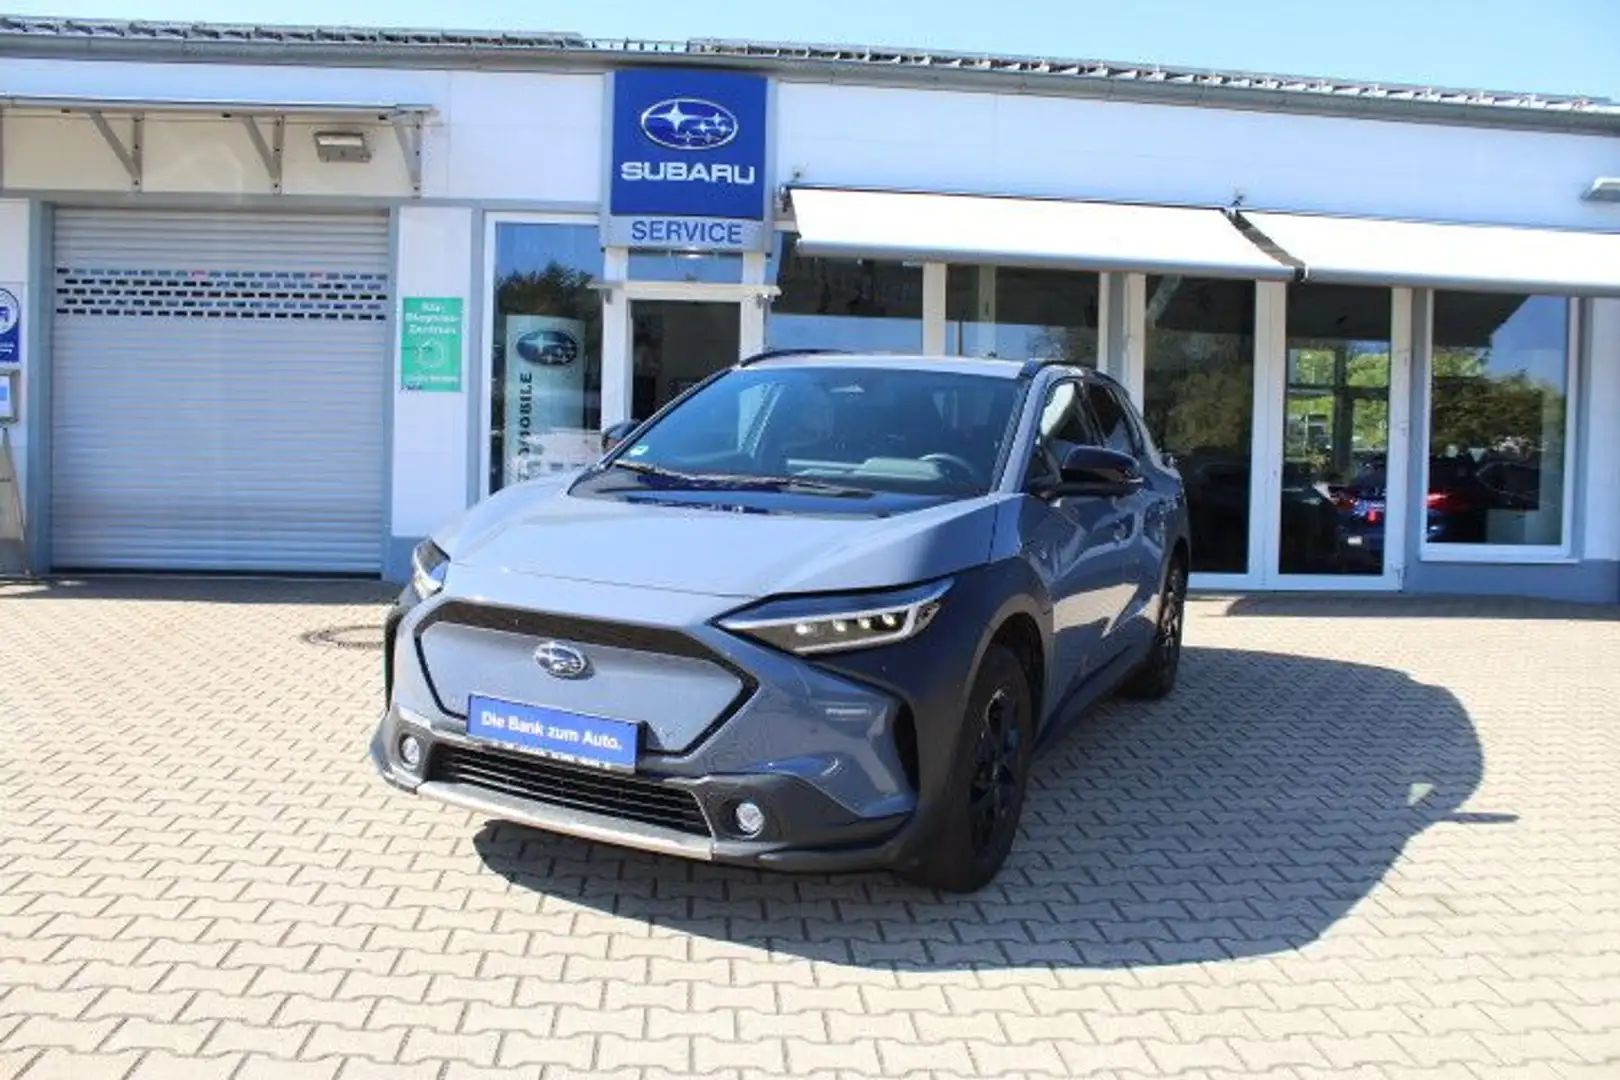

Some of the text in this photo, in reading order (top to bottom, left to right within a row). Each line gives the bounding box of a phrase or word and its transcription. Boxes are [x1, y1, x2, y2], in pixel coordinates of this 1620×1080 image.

[620, 161, 756, 185] SUBARU
[631, 220, 743, 244] SERVICE
[480, 710, 623, 750] Die Bank zum Auto.
